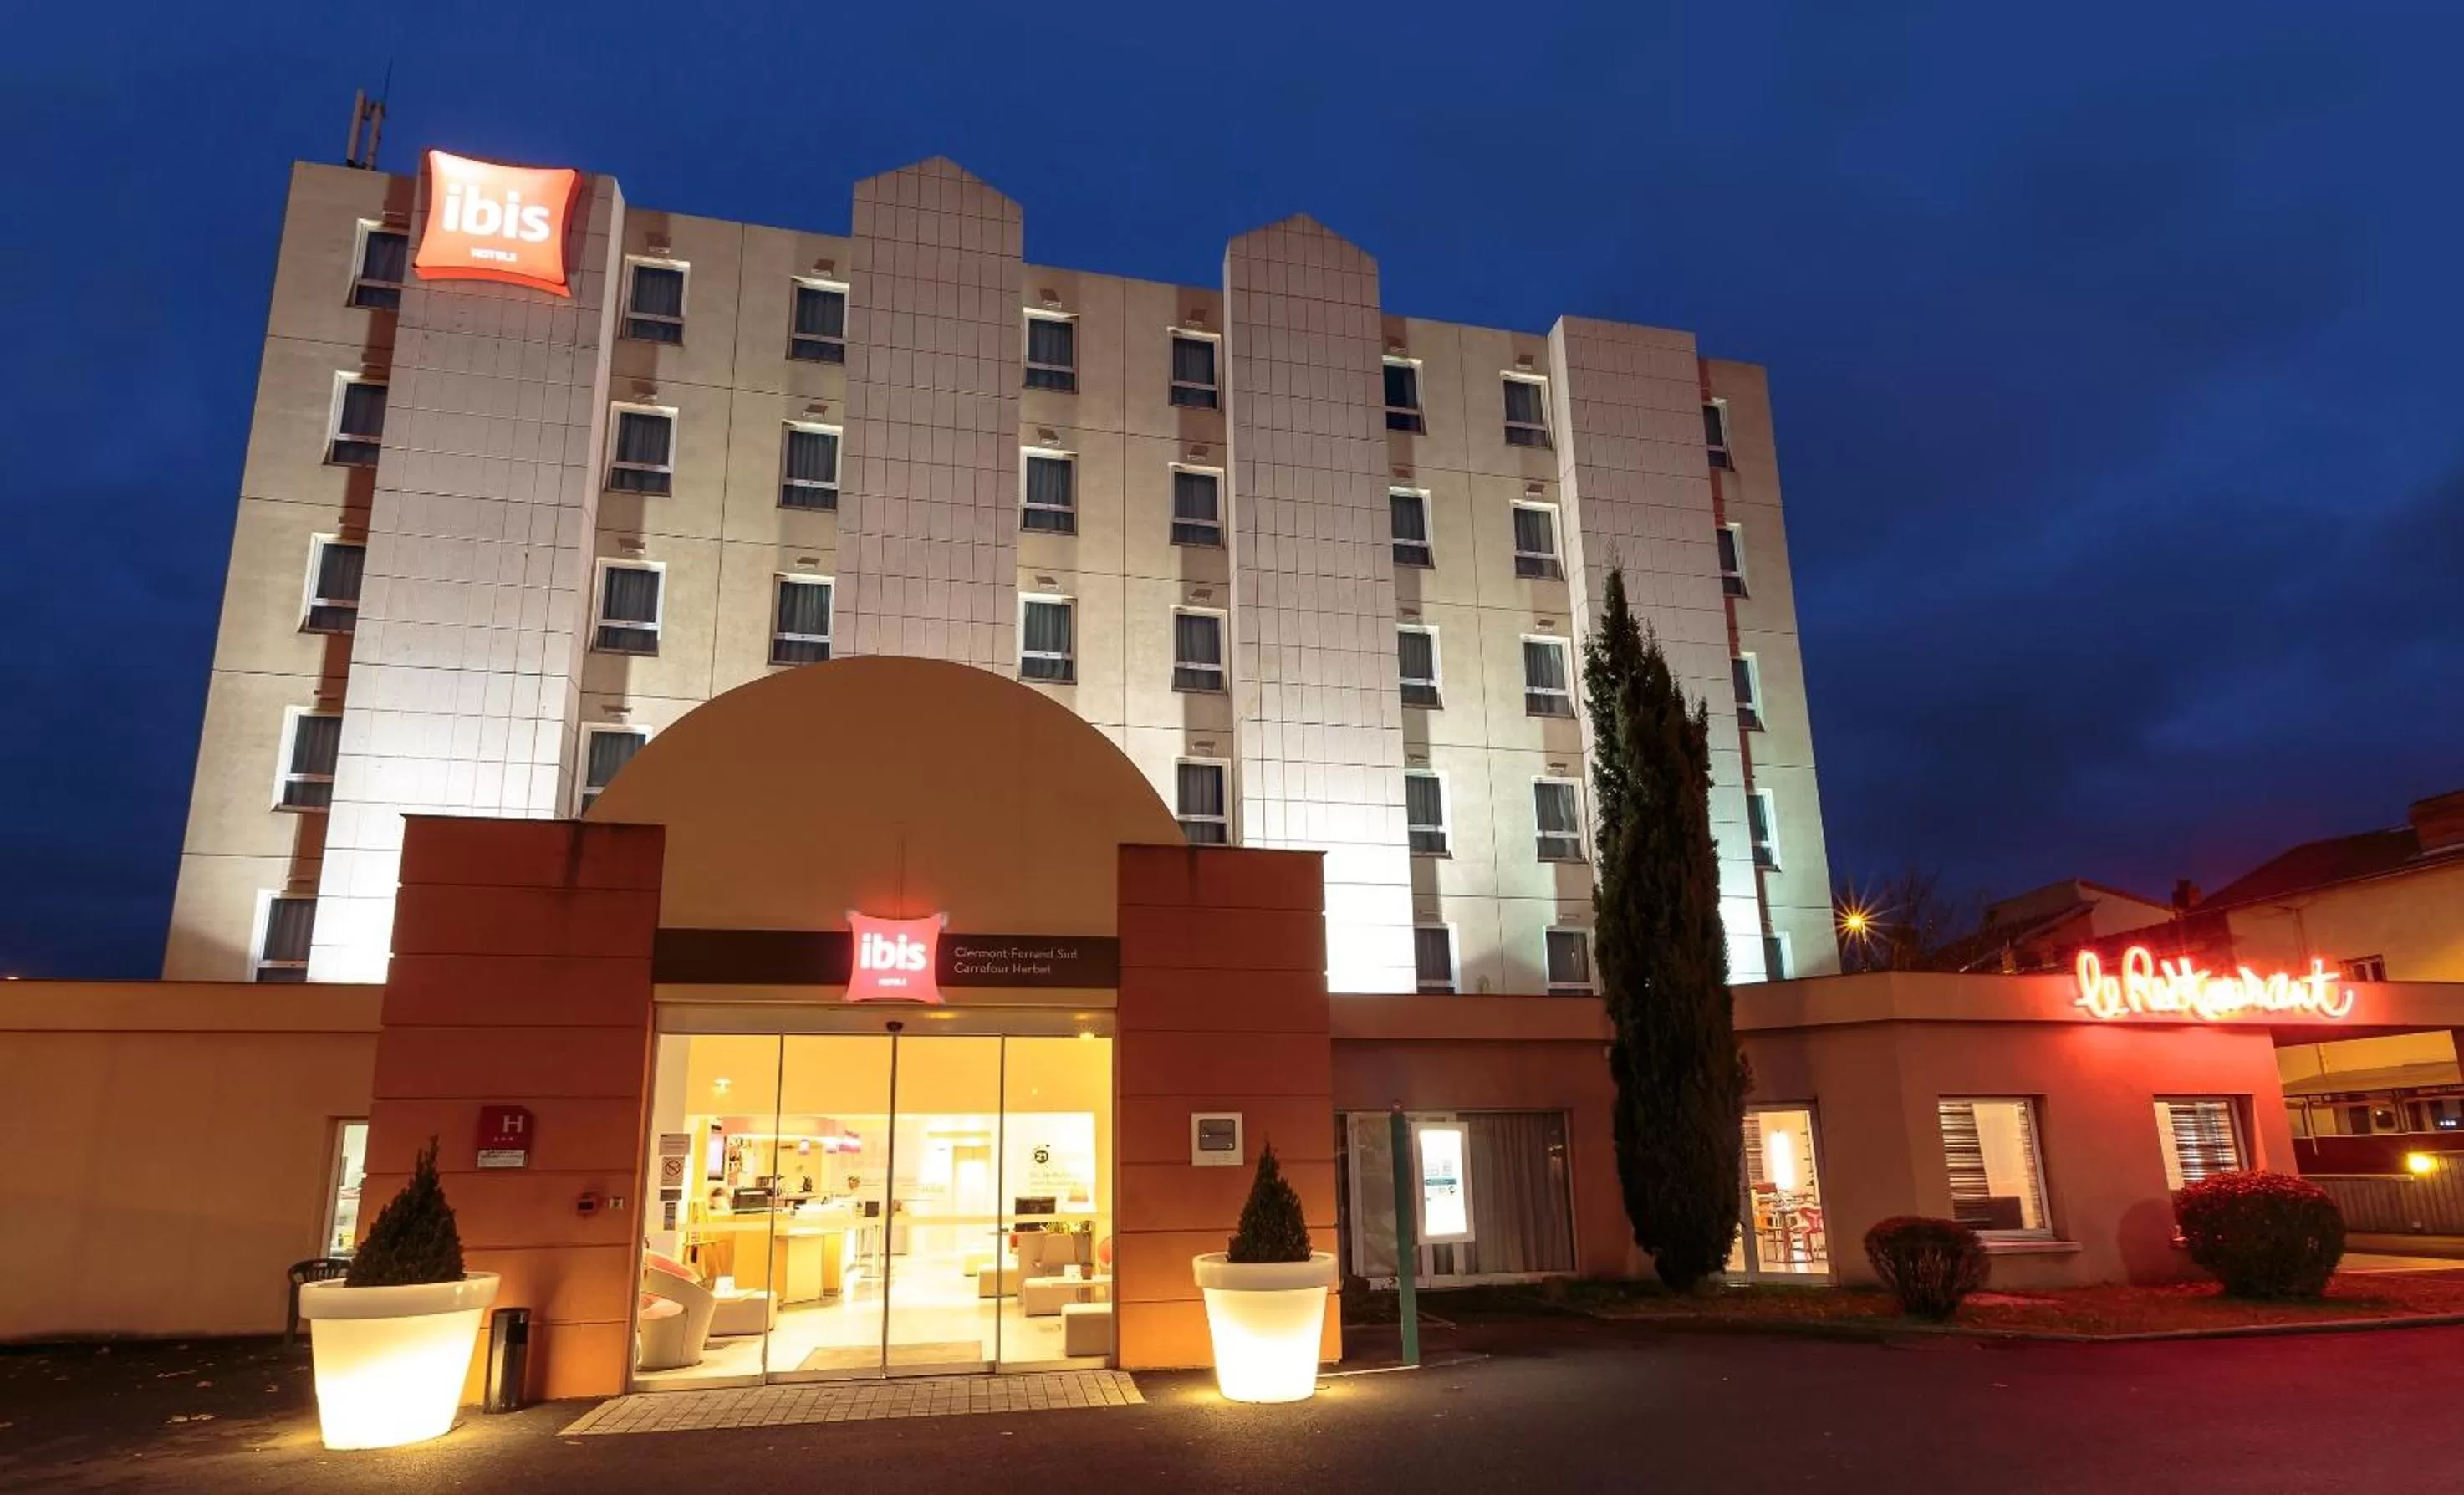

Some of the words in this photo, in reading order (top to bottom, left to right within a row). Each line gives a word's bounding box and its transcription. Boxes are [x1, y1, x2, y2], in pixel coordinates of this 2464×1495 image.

[441, 182, 550, 242] ibis
[860, 933, 926, 970] ibis
[1057, 948, 1078, 959] Sud
[953, 962, 1009, 974] Carrefour
[1013, 962, 1051, 974] Herbet
[502, 1115, 524, 1133] H
